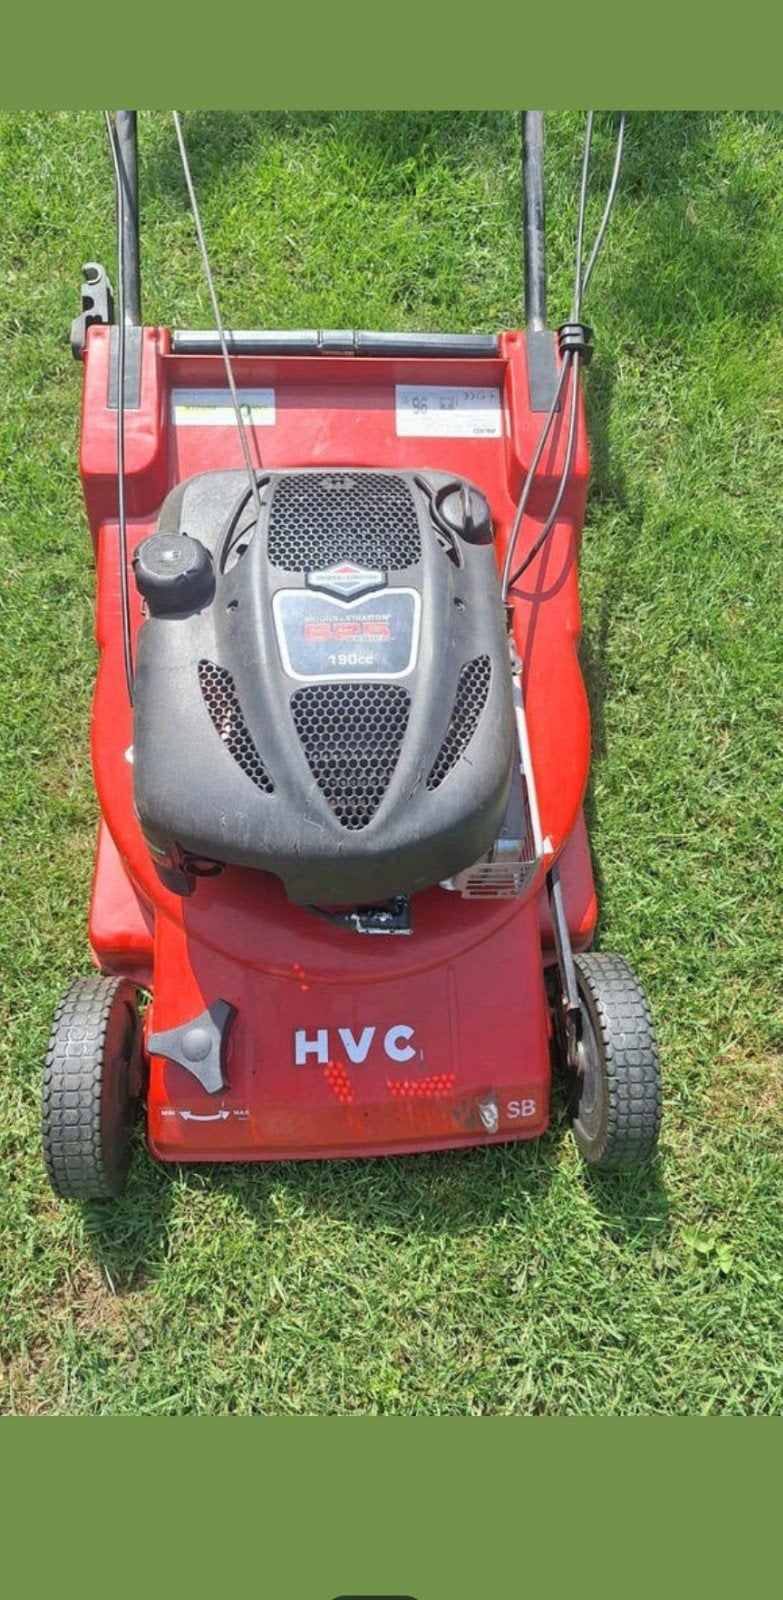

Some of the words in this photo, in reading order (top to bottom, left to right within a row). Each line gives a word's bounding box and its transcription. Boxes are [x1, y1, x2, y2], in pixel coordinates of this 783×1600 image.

[328, 653, 374, 667] 190cc
[295, 1024, 417, 1065] HVC
[506, 1099, 536, 1119] SB
